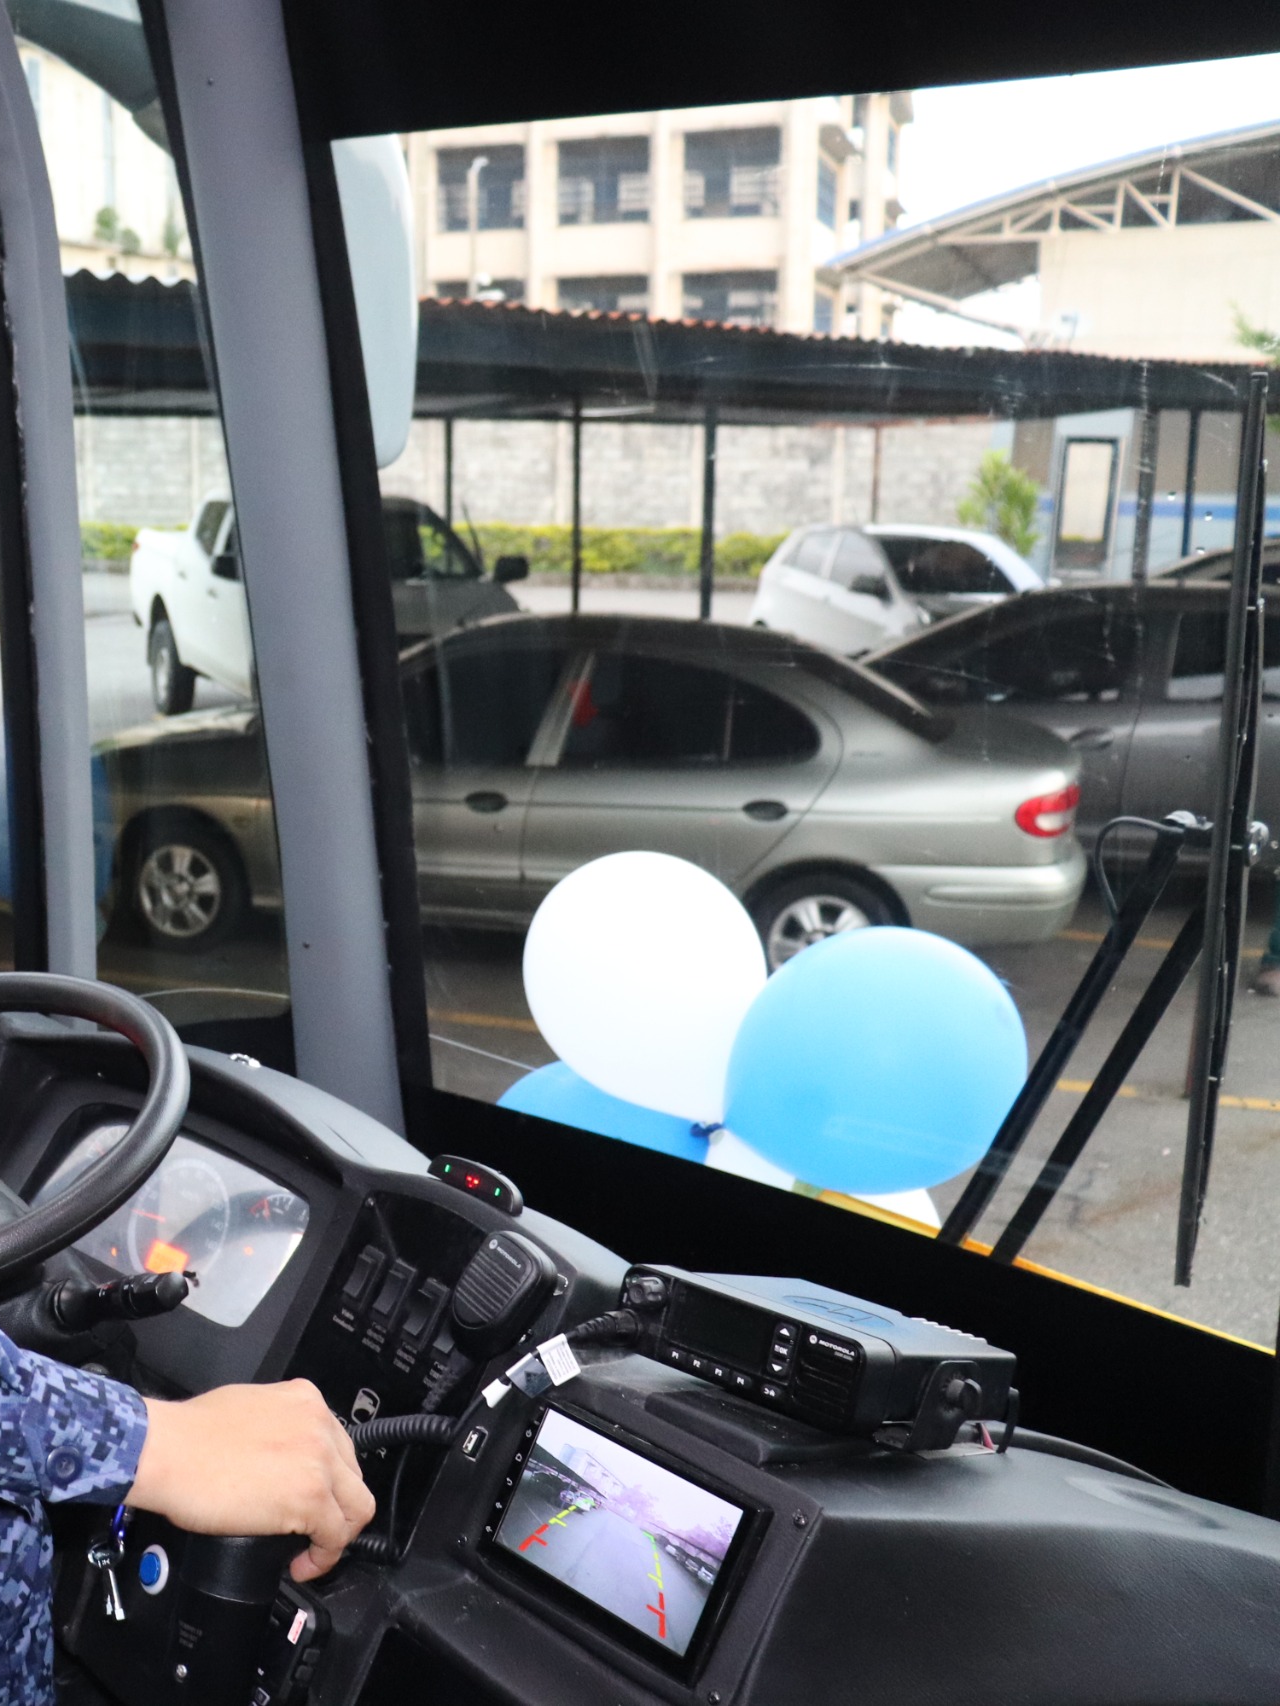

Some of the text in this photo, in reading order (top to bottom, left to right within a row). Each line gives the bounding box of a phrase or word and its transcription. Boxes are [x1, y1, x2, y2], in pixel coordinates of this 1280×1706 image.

[818, 1339, 855, 1357] MOTOROLA
[671, 1351, 679, 1360] P1
[692, 1359, 701, 1368] P2
[714, 1367, 723, 1377] P3
[736, 1376, 745, 1386] P4
